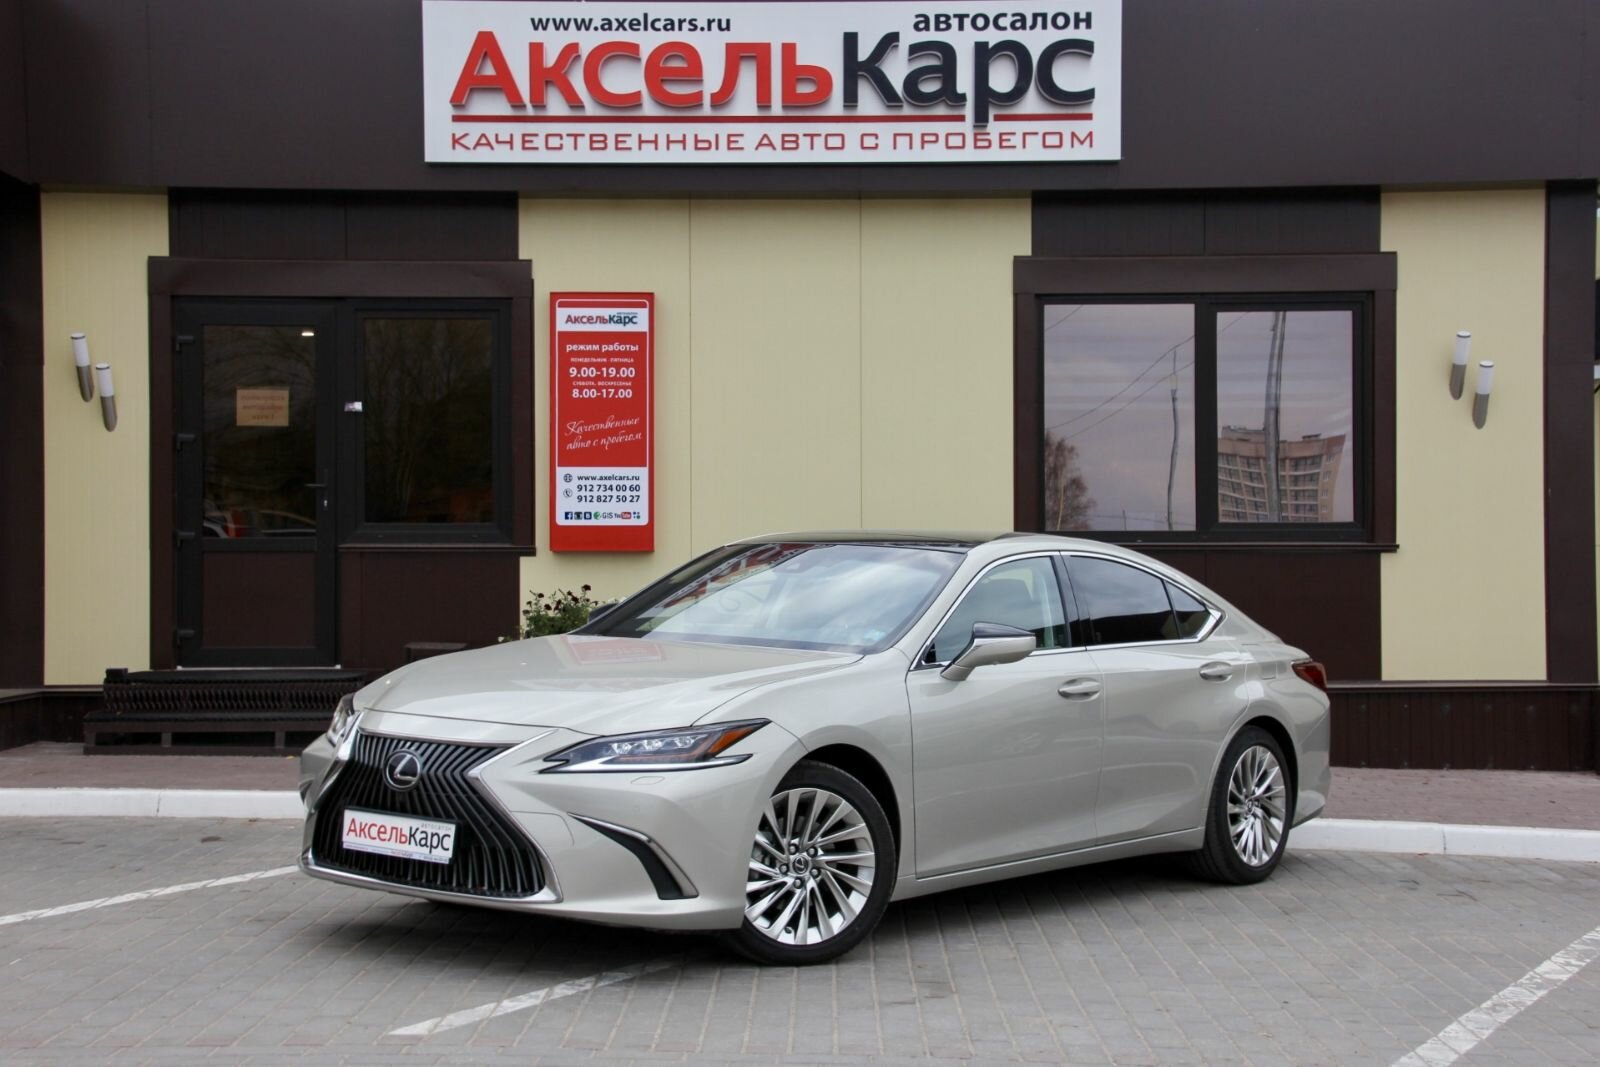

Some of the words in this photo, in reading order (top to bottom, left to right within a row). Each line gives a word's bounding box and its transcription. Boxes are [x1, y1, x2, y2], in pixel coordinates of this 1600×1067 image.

[530, 15, 732, 33] www.axelcars.ru
[913, 11, 1093, 32] автосалон
[450, 30, 1095, 128] АксельКарс
[451, 132, 745, 151] КАЧЕСТВЕННЫЕ
[755, 132, 847, 151] АВТО
[857, 132, 880, 151] С
[893, 130, 1094, 151] ПРОБЕГОМ
[565, 314, 638, 326] АксельКарс
[566, 343, 600, 352] режим
[602, 342, 639, 352] работы
[569, 367, 635, 378] 9.00-19.00
[572, 389, 633, 399] 8.00-17.00
[577, 474, 640, 482] www.axelcars.ru
[577, 484, 594, 492] 912
[596, 484, 613, 492] 734
[615, 484, 627, 492] 00
[629, 484, 641, 492] 60
[577, 495, 594, 503] 912
[596, 495, 613, 503] 827
[615, 495, 627, 503] 50
[629, 495, 641, 503] 27
[346, 818, 451, 854] АксельКарс
